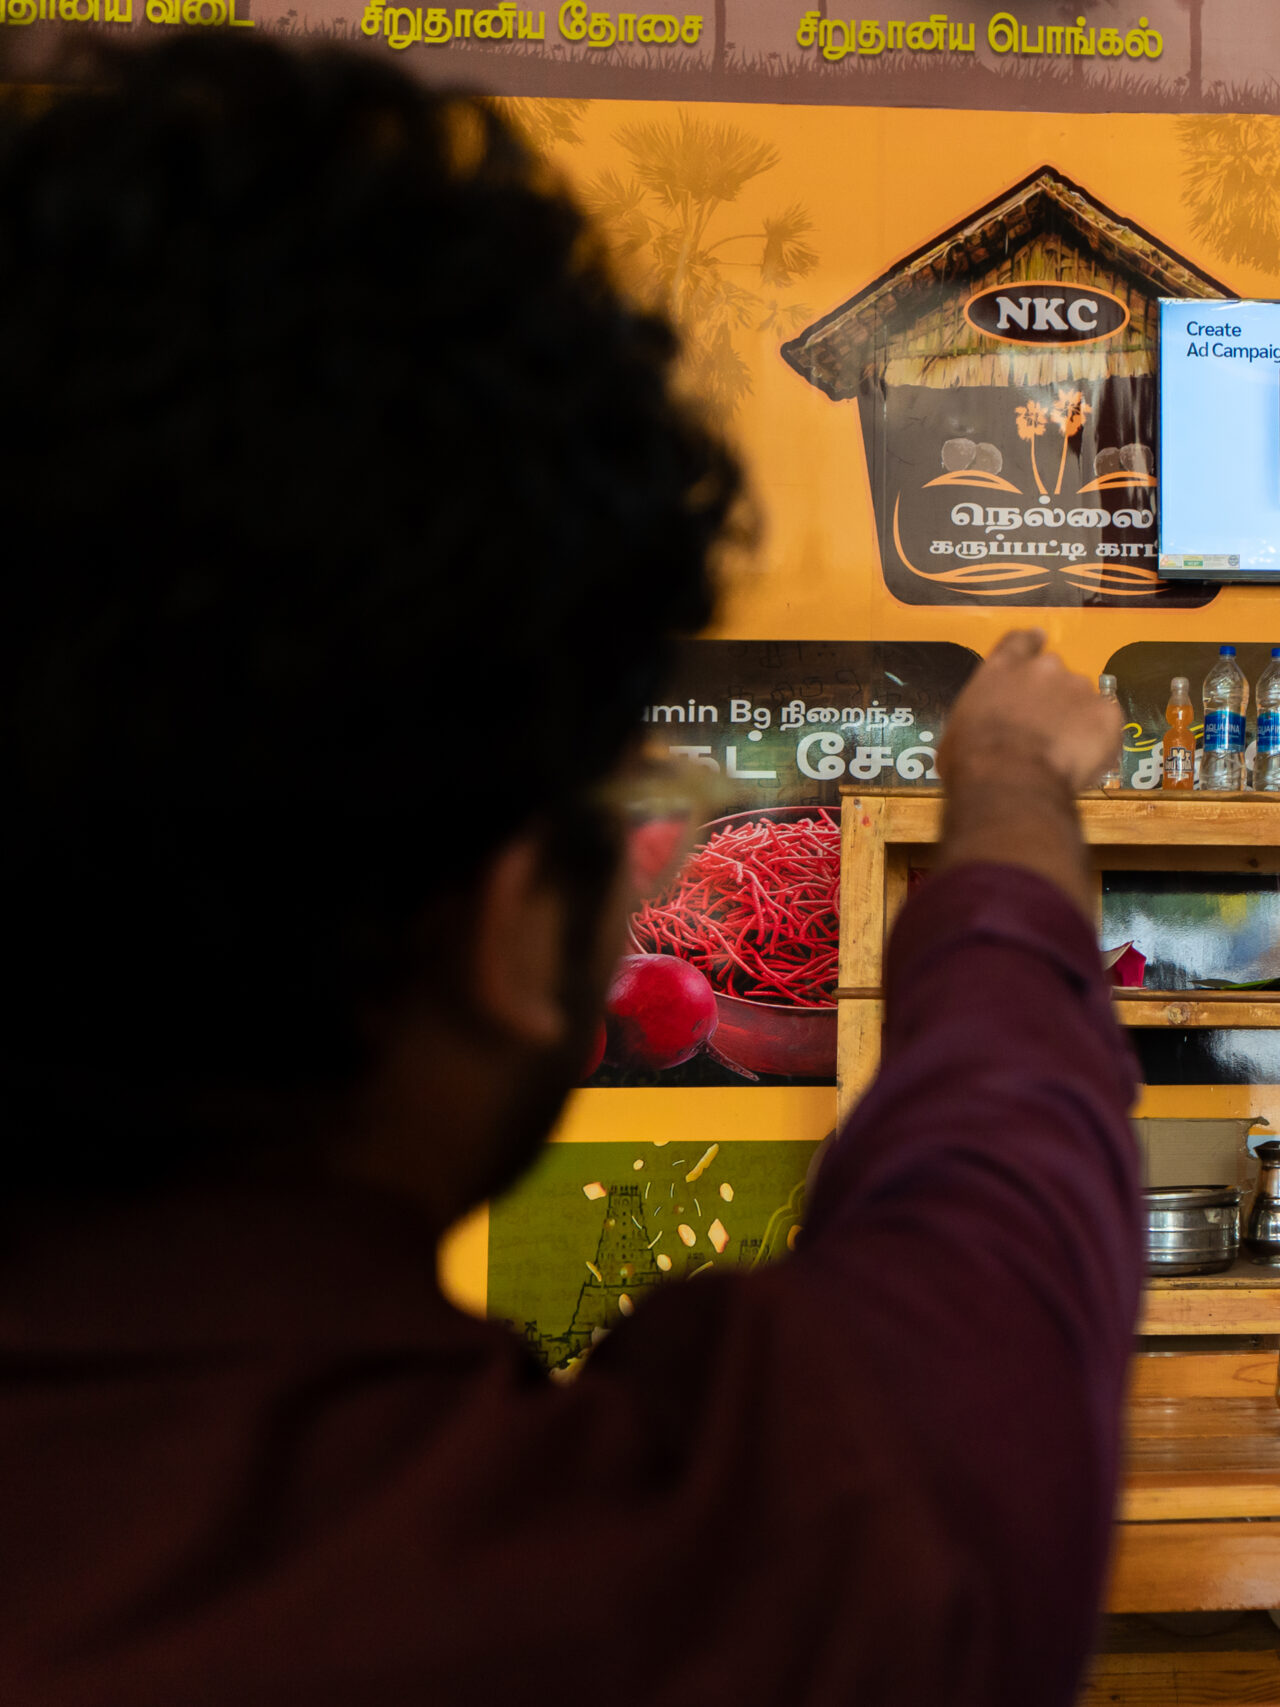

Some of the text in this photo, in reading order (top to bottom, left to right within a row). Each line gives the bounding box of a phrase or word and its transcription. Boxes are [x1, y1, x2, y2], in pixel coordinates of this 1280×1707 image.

[0, 0, 132, 25] தானிய
[361, 0, 703, 50] சிறுதானிய தோசை
[796, 11, 1163, 60] சிறுதானிய பொங்கல்
[996, 297, 1098, 331] NKC
[1186, 320, 1242, 338] Create
[1186, 342, 1209, 358] Ad
[951, 495, 1153, 534] நெல்லை
[929, 533, 1087, 561] கருப்பட்டி
[730, 700, 771, 728] B9
[780, 699, 914, 731] நிறைந்த
